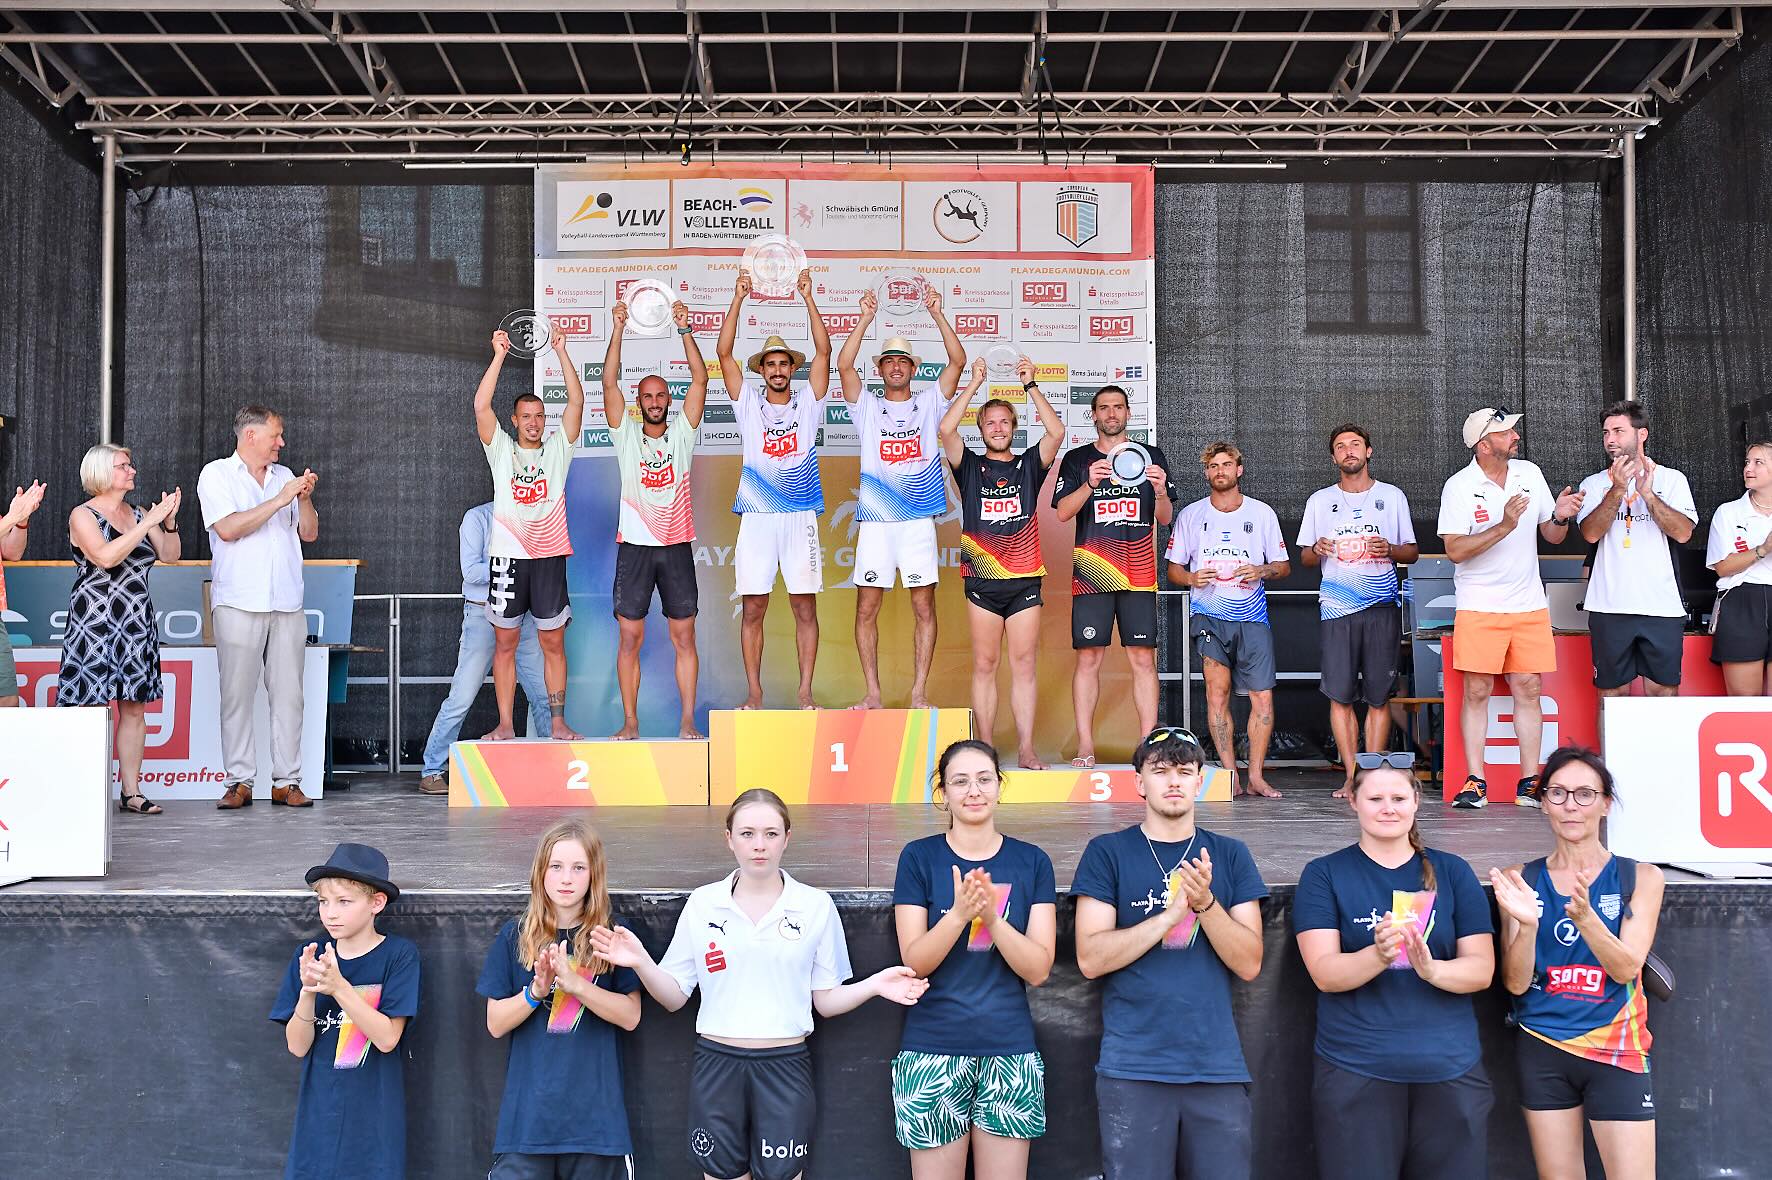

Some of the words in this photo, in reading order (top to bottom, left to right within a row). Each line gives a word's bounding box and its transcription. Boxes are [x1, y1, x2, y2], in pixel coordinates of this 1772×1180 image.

[683, 199, 737, 212] BEACH-
[616, 209, 666, 227] VLW
[684, 215, 775, 230] VOLLEYBALL
[557, 263, 678, 273] PLAYADEGAMUNDIA.COM
[1011, 267, 1131, 276] PLAYADEGAMUNDIA.COM
[557, 287, 603, 296] Kreissparkasse
[964, 289, 1010, 297] Kreissparkasse
[1025, 284, 1064, 300] sorg
[1099, 290, 1145, 298] Kreissparkasse
[760, 321, 806, 329] Kreissparkasse
[957, 316, 996, 332] sorg
[1033, 323, 1078, 331] Kreissparkasse
[1092, 318, 1131, 334] sorg
[1042, 367, 1066, 375] LOTTO
[545, 389, 568, 399] AOK
[882, 438, 919, 456] sorg
[1097, 499, 1137, 518] sorg
[1331, 504, 1338, 513] 2
[1202, 522, 1208, 532] 1
[829, 743, 849, 772] 1
[566, 760, 590, 790] 2
[1089, 772, 1112, 801] 3
[1562, 923, 1576, 942] 2
[1550, 967, 1603, 992] sorg
